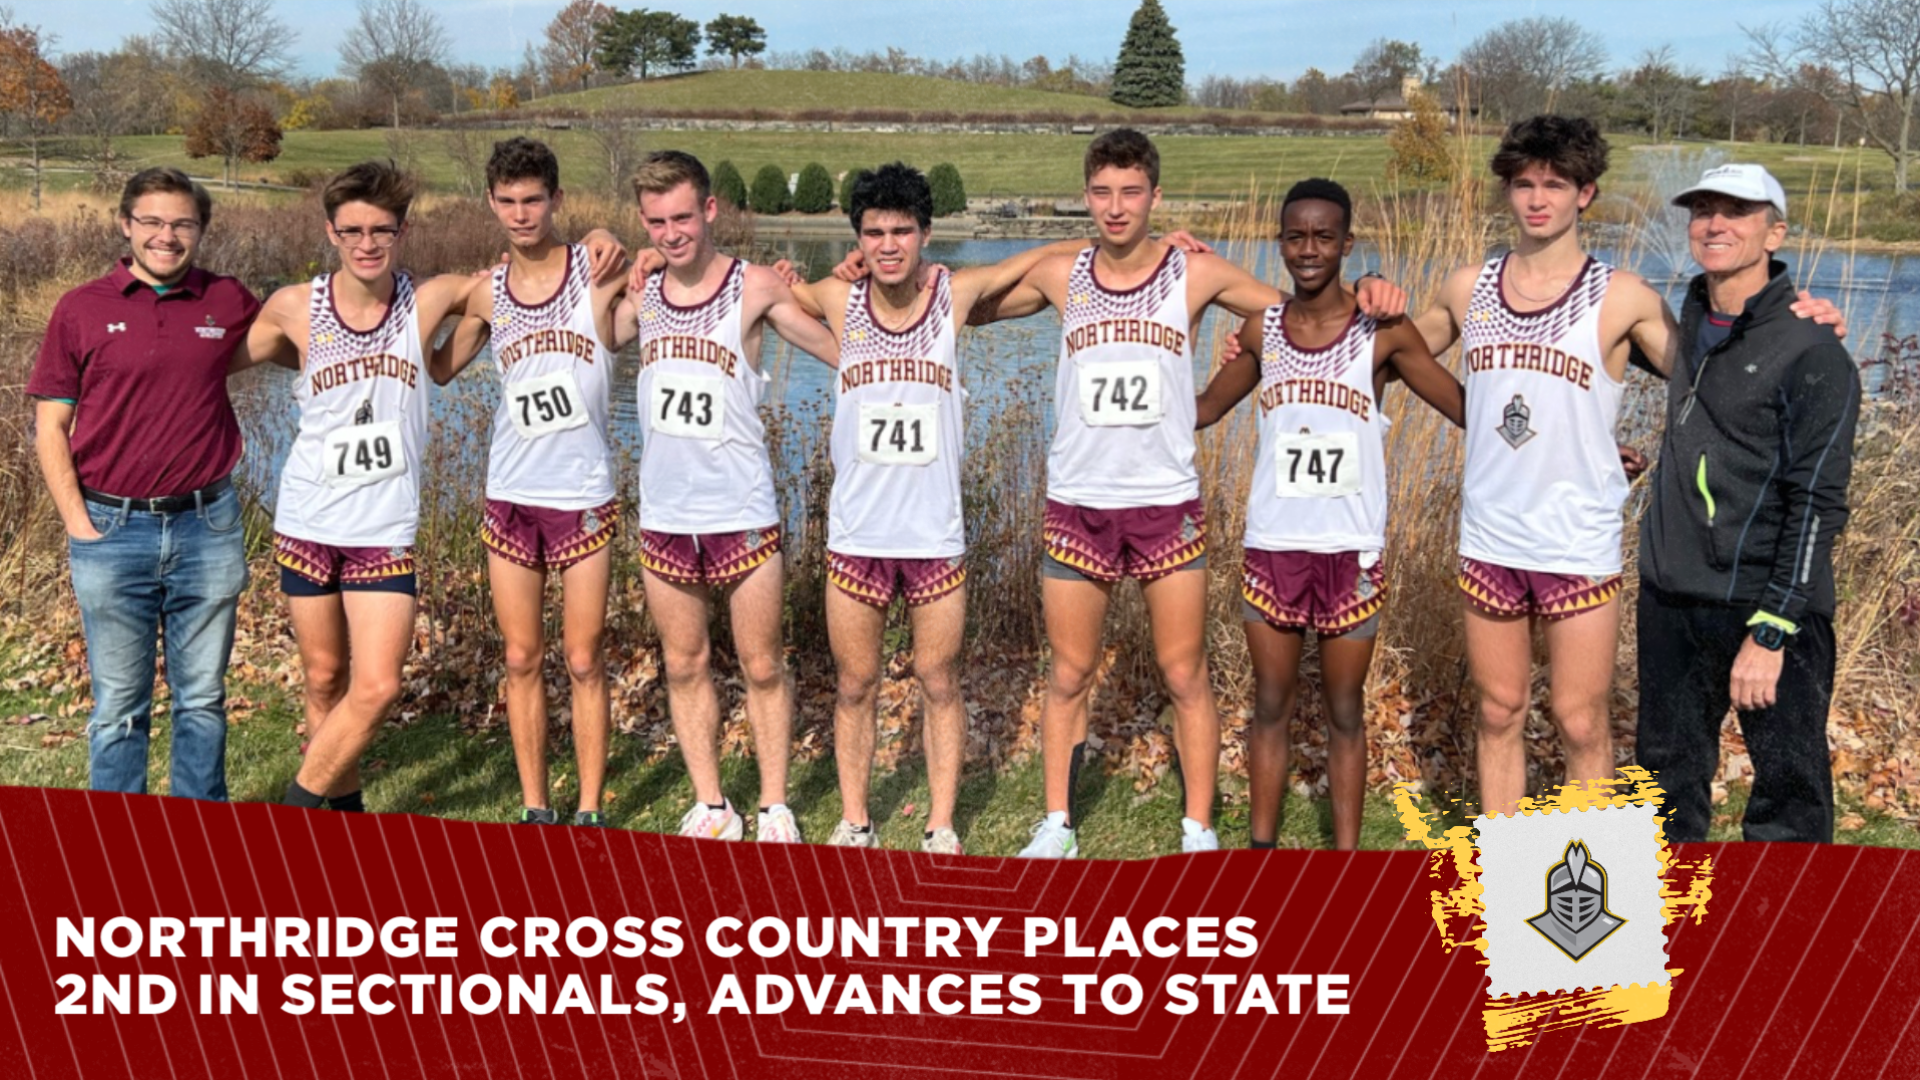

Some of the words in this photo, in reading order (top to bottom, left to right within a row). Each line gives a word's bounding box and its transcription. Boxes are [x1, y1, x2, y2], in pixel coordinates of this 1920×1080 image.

[639, 335, 739, 379] ORTHRIDGE
[1065, 318, 1186, 358] NORTHRIDGE
[840, 357, 953, 394] NORTHRIDGE
[1090, 375, 1149, 412] 742
[515, 385, 573, 428] 750
[660, 388, 713, 427] 743
[870, 418, 925, 453] 741
[333, 435, 393, 476] 749
[1286, 447, 1345, 484] 747
